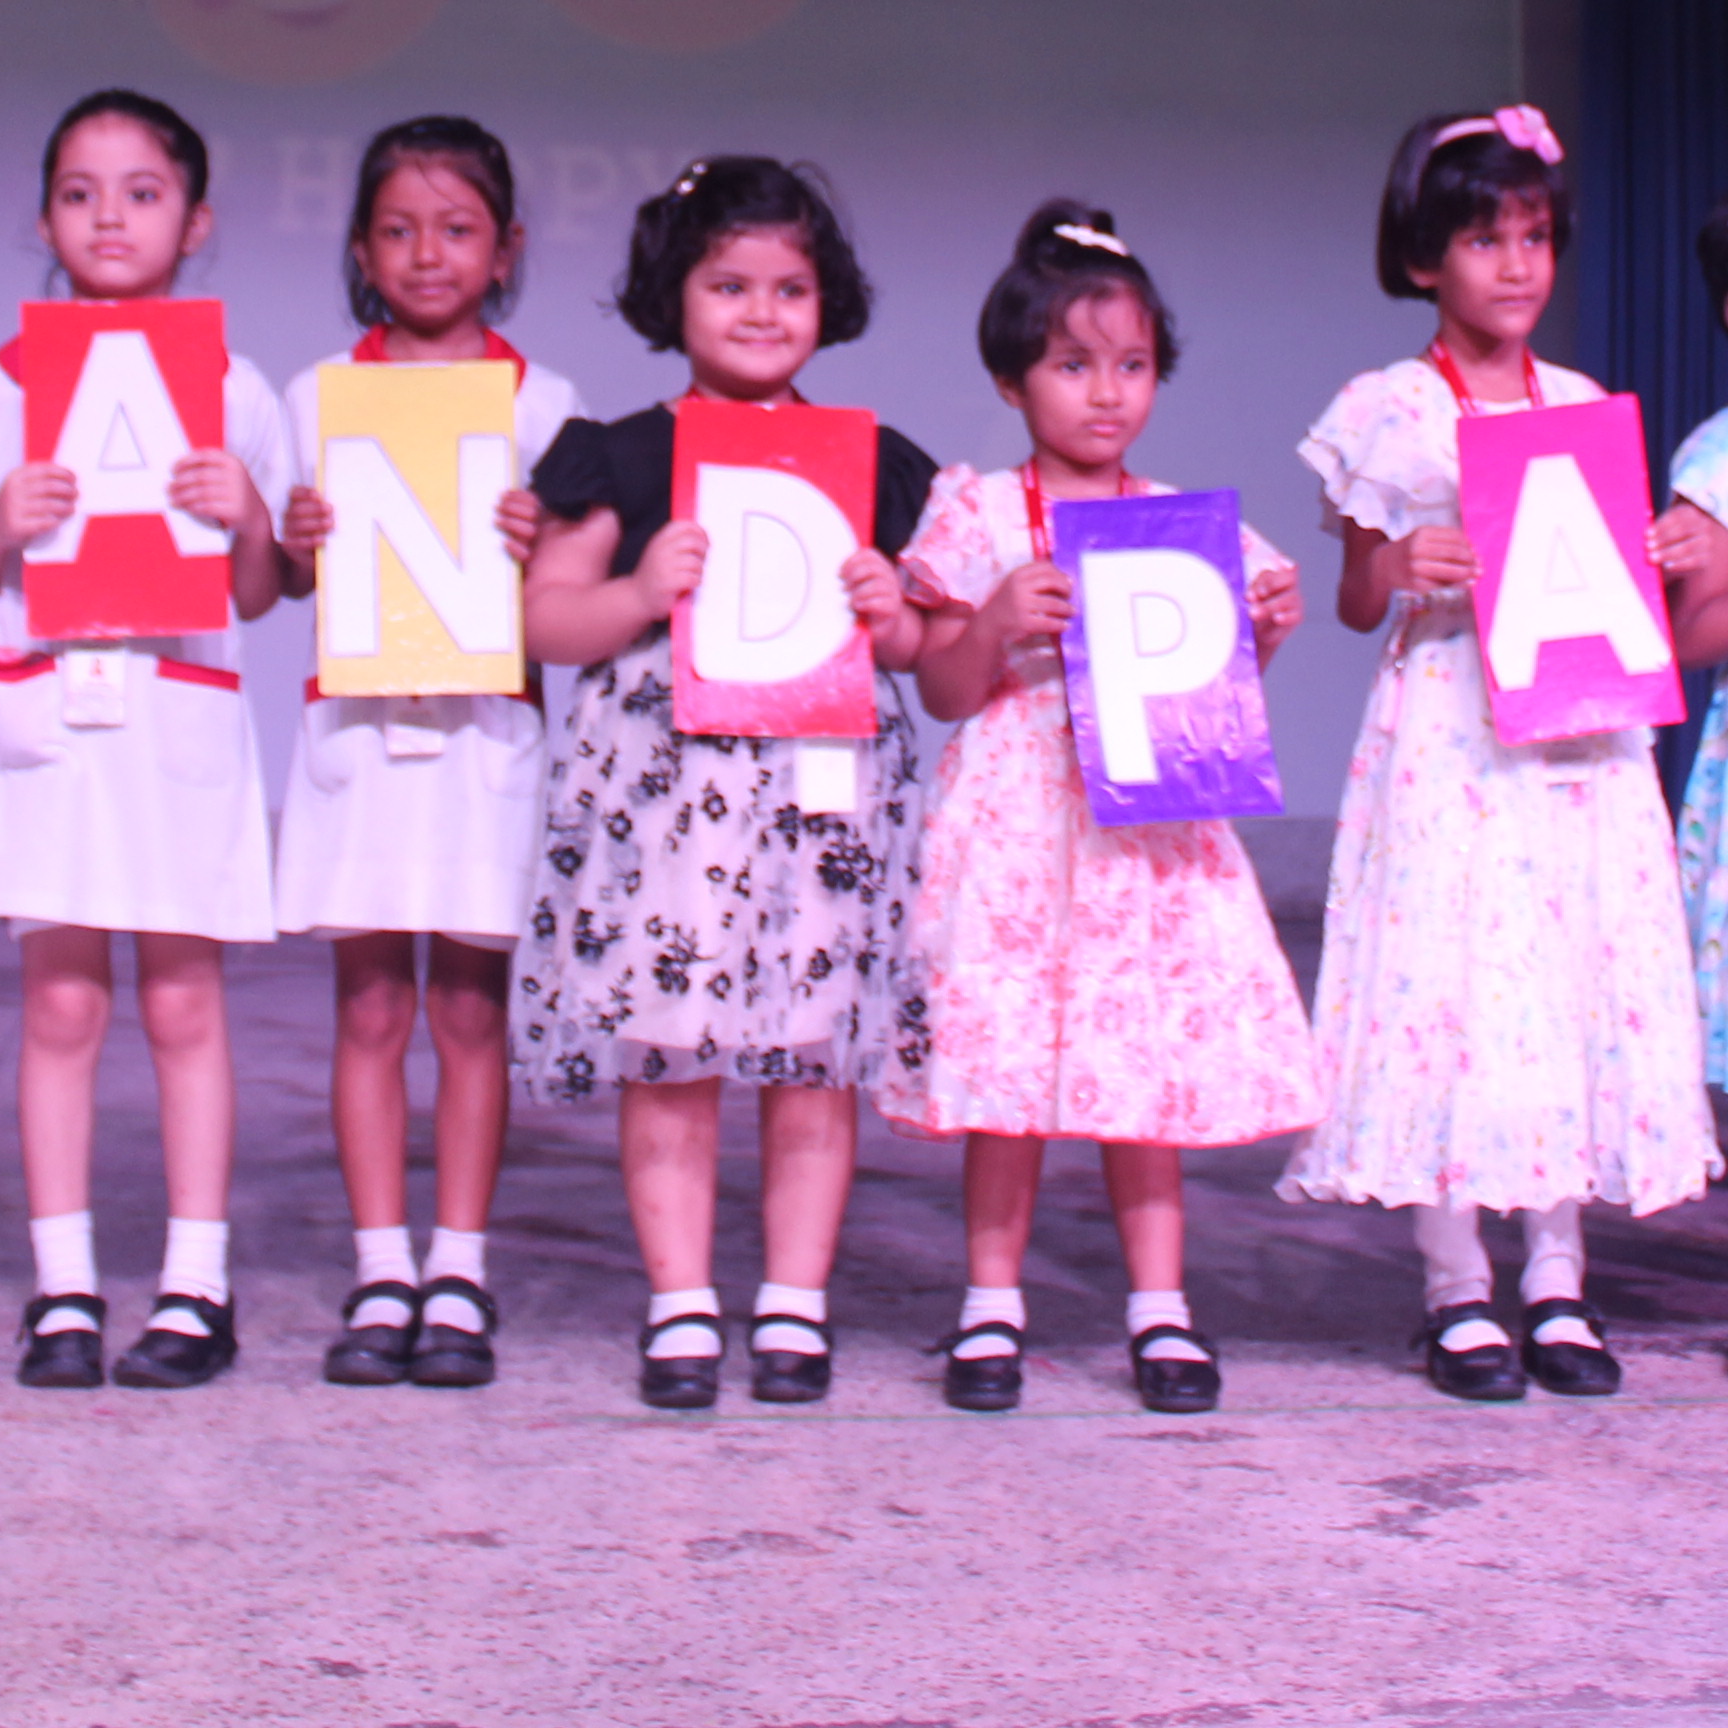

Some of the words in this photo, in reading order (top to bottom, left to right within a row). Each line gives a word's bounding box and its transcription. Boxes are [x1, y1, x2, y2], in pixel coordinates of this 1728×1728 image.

[25, 330, 229, 563] A
[325, 435, 518, 658] N
[690, 462, 860, 683] D
[1080, 549, 1237, 784] P
[1487, 455, 1672, 691] A
